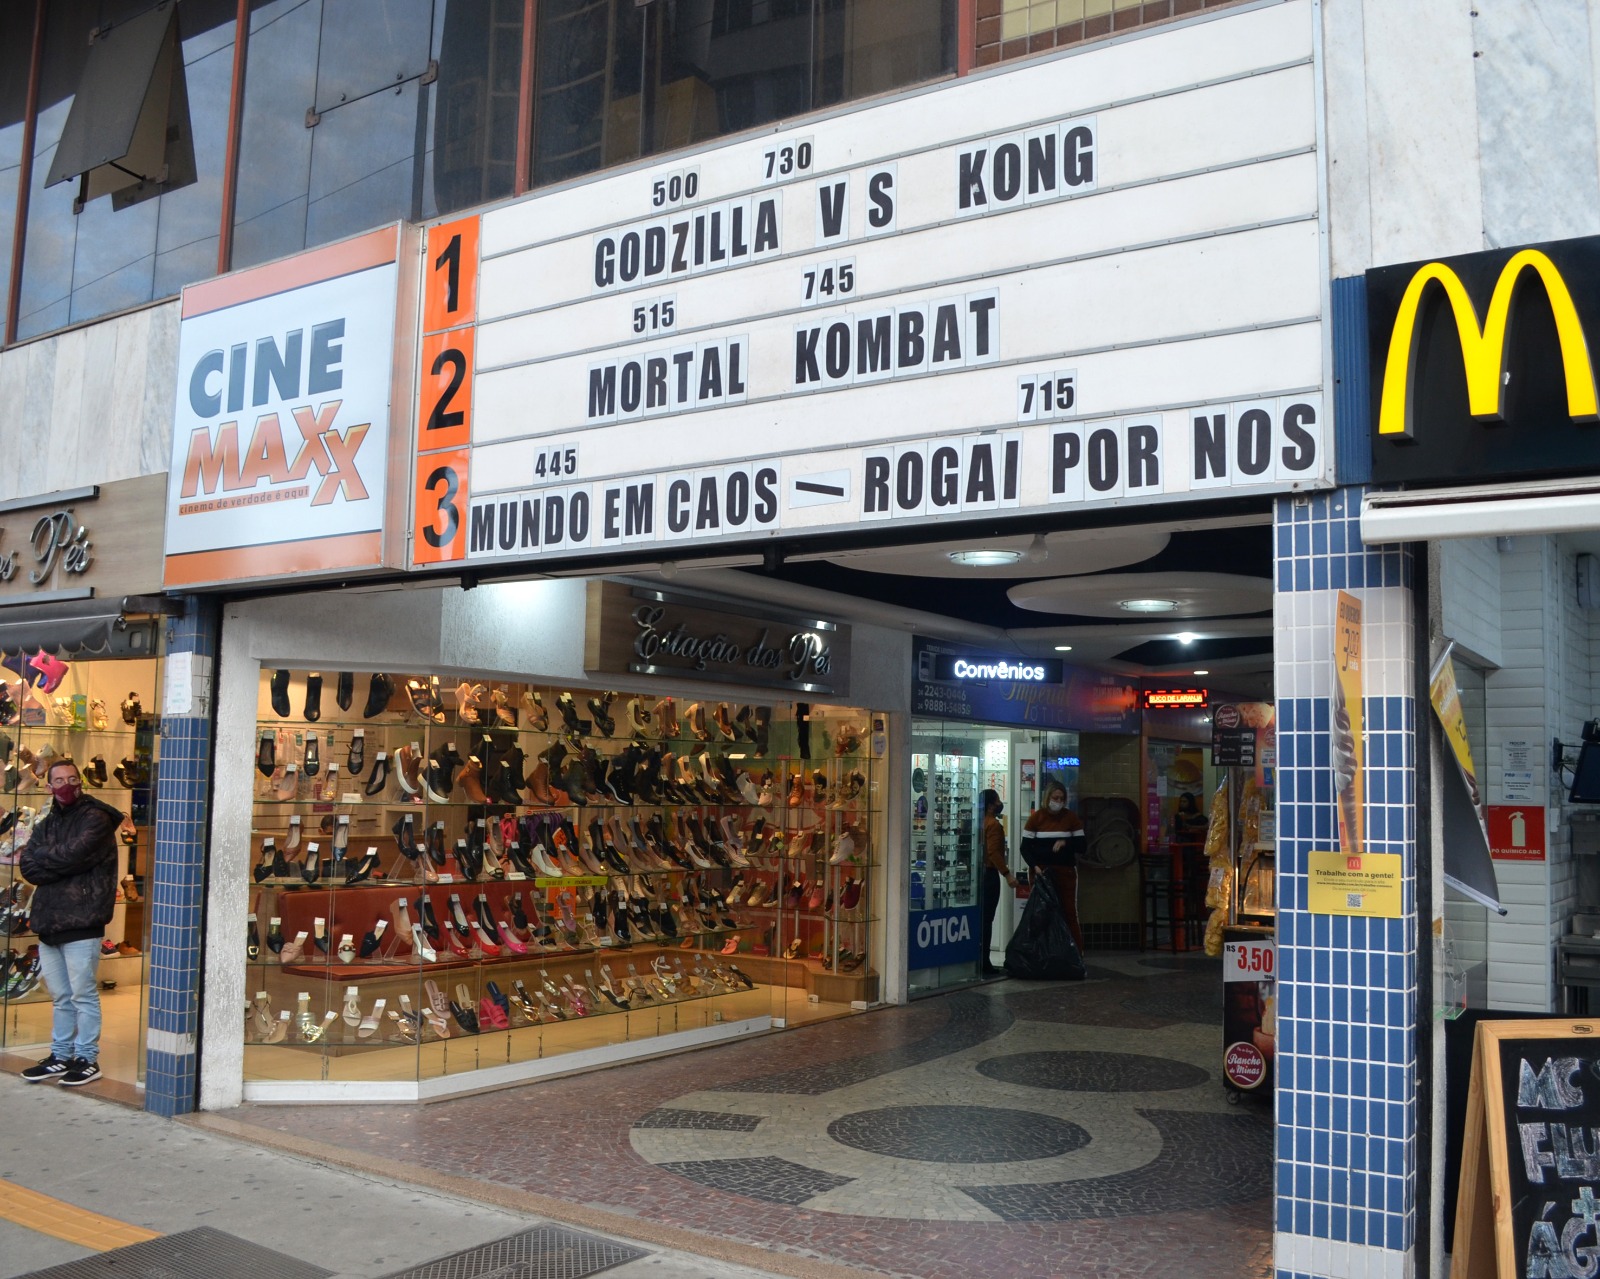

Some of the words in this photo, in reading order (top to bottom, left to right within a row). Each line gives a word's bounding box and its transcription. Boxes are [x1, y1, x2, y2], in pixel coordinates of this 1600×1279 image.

[594, 199, 779, 289] GODZILLA
[959, 126, 1094, 210] KONG
[652, 172, 698, 207] 500
[764, 142, 812, 179] 730
[435, 233, 462, 313] 1
[633, 300, 675, 333] 515
[803, 264, 854, 300] 745
[189, 318, 346, 418] CINE
[426, 348, 467, 431] 2
[588, 342, 745, 418] MORTAL
[795, 297, 996, 385] KOMBAT
[180, 399, 371, 507] MAXX
[535, 448, 577, 479] 445
[1020, 377, 1074, 414] 715
[180, 501, 213, 515] cinema
[217, 496, 228, 509] de
[231, 491, 273, 507] verdade
[275, 489, 281, 501] é
[284, 485, 309, 502] aqui
[422, 465, 460, 548] 3
[470, 491, 589, 552] MUNDO
[604, 483, 653, 539] EM
[667, 467, 778, 533] CAOS
[863, 440, 1019, 513] ROGAI
[1052, 424, 1159, 494] POR
[1194, 403, 1317, 480] NOS
[28, 508, 92, 584] Pés
[631, 604, 741, 671] Estação
[747, 627, 784, 669] dos
[789, 632, 832, 681] Pés
[954, 660, 1045, 681] Convênios
[1316, 869, 1347, 877] Trabalhe
[917, 914, 971, 948] ÓTICA
[1226, 944, 1236, 952] R$
[1237, 945, 1273, 973] 3,50
[1227, 1053, 1261, 1066] Rancho
[1236, 1065, 1260, 1075] Minas
[1517, 1057, 1584, 1110] MC
